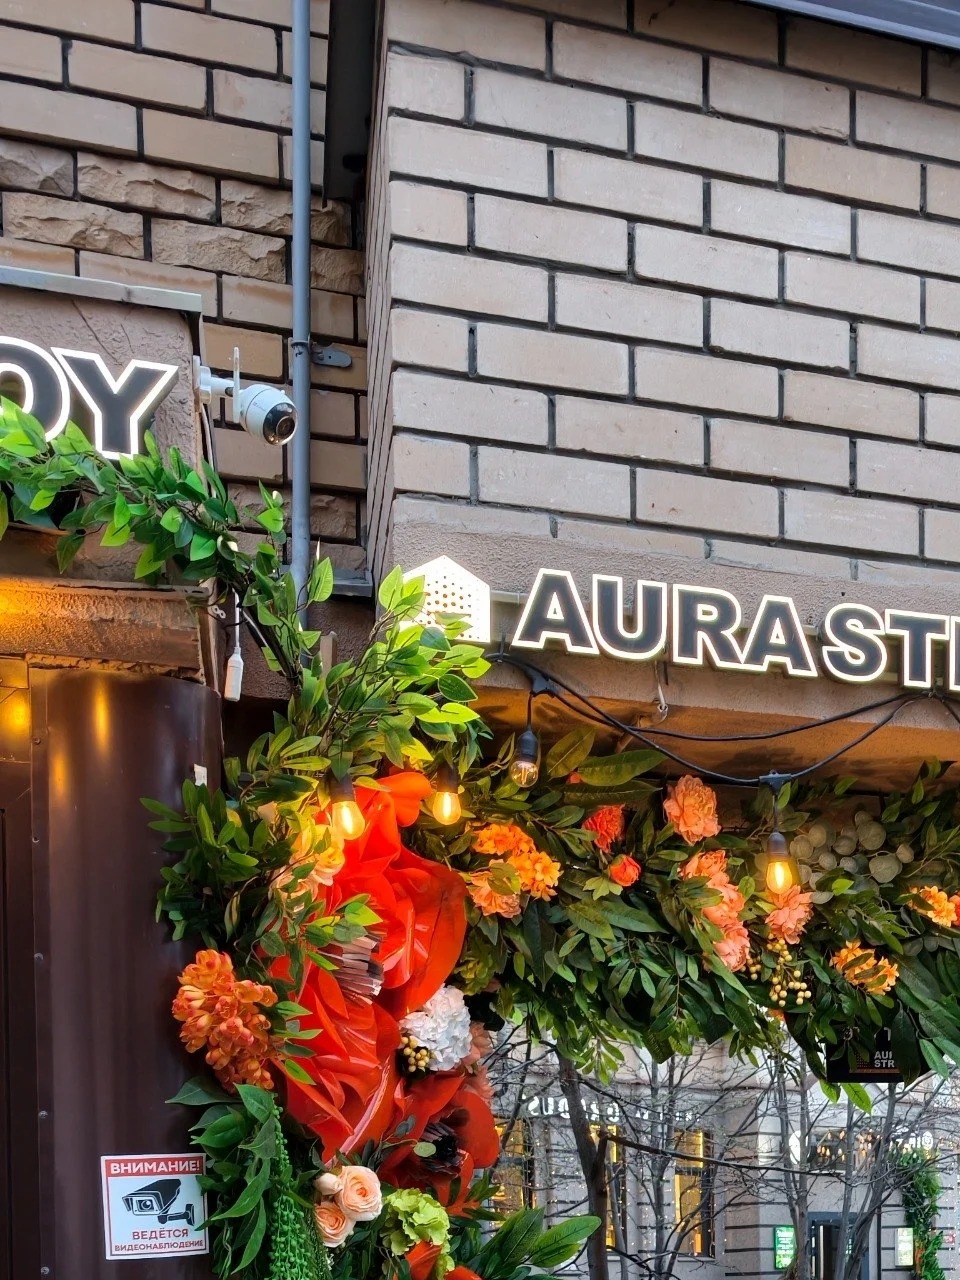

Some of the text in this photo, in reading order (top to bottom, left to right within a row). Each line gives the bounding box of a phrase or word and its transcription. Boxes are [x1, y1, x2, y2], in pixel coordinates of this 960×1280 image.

[110, 1160, 200, 1175] ВНИМАНИЕ!
[132, 1227, 189, 1241] ВЕДЁТСЯ
[114, 1239, 204, 1252] ВИДЕОНАБЛЮДЕНИЕ
